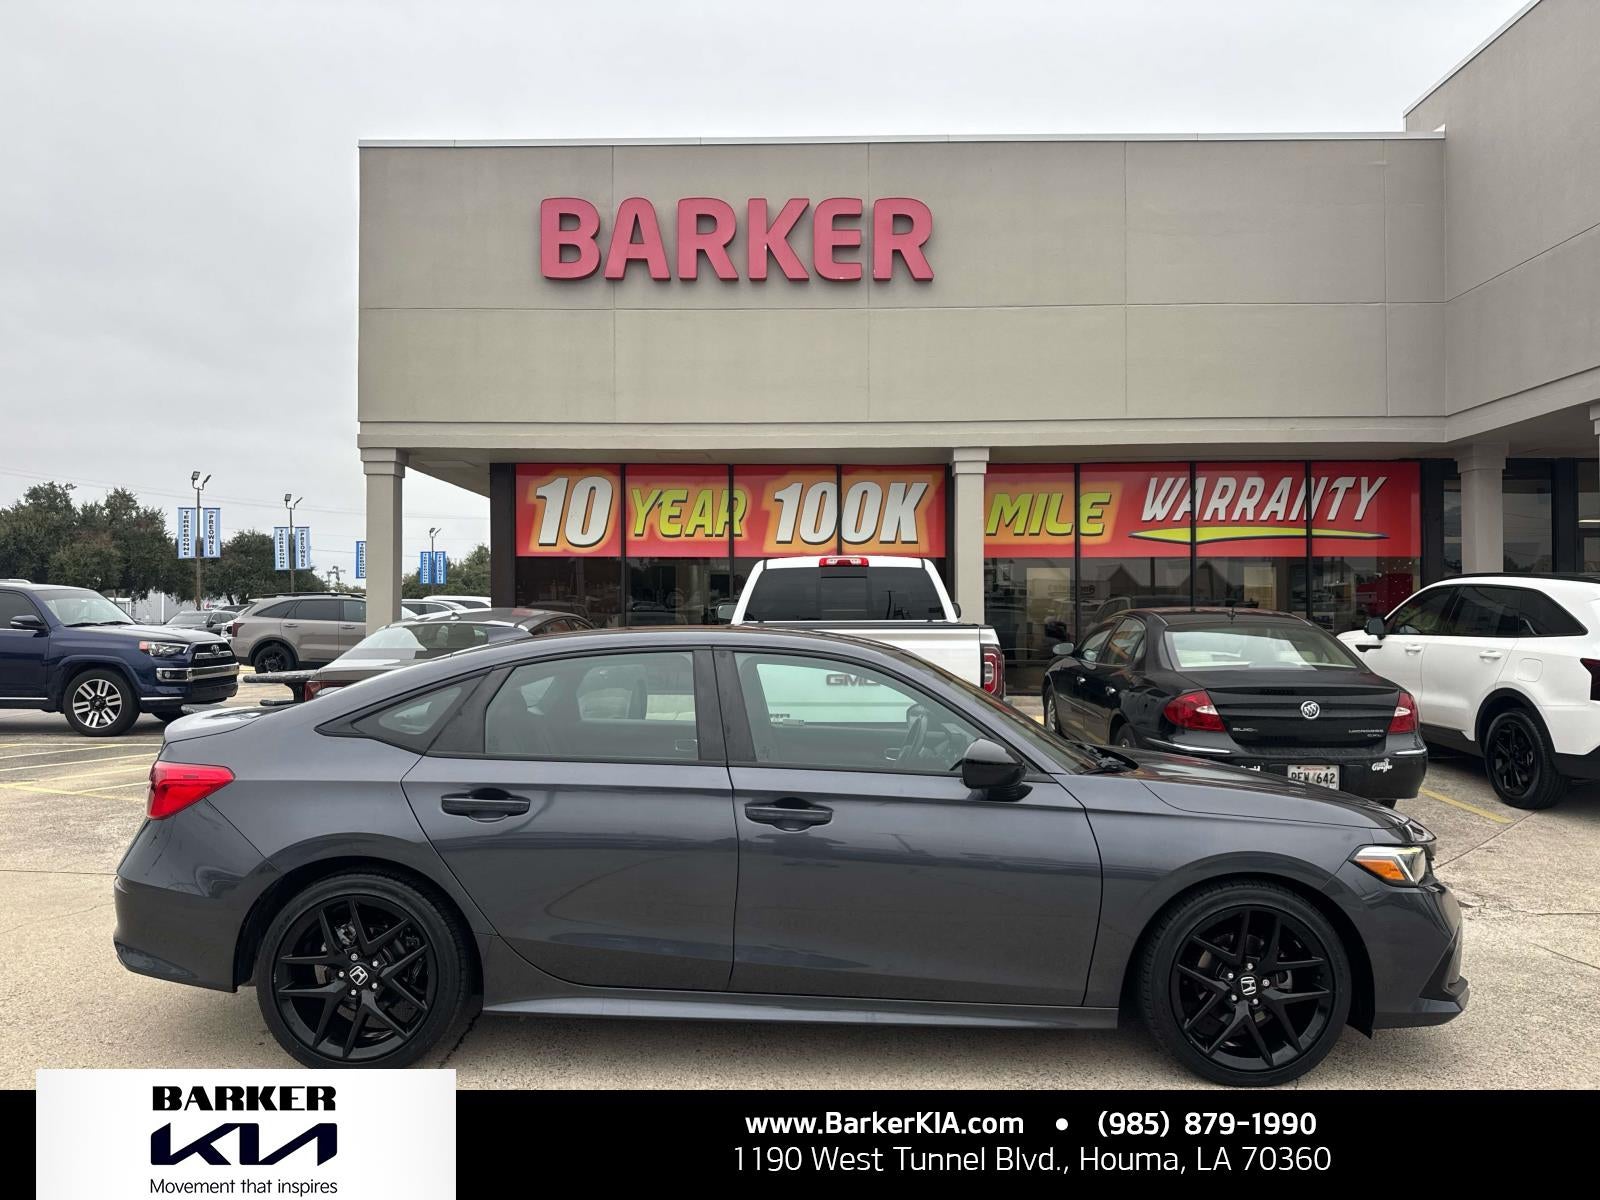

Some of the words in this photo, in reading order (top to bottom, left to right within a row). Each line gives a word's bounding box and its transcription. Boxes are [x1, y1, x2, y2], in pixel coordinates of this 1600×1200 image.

[540, 197, 935, 282] BARKER
[535, 476, 614, 548] 10
[631, 488, 748, 538] YEAR
[774, 481, 930, 545] 100K
[985, 491, 1112, 537] MILE
[1141, 476, 1388, 522] WARRANTY
[1316, 771, 1336, 784] 642
